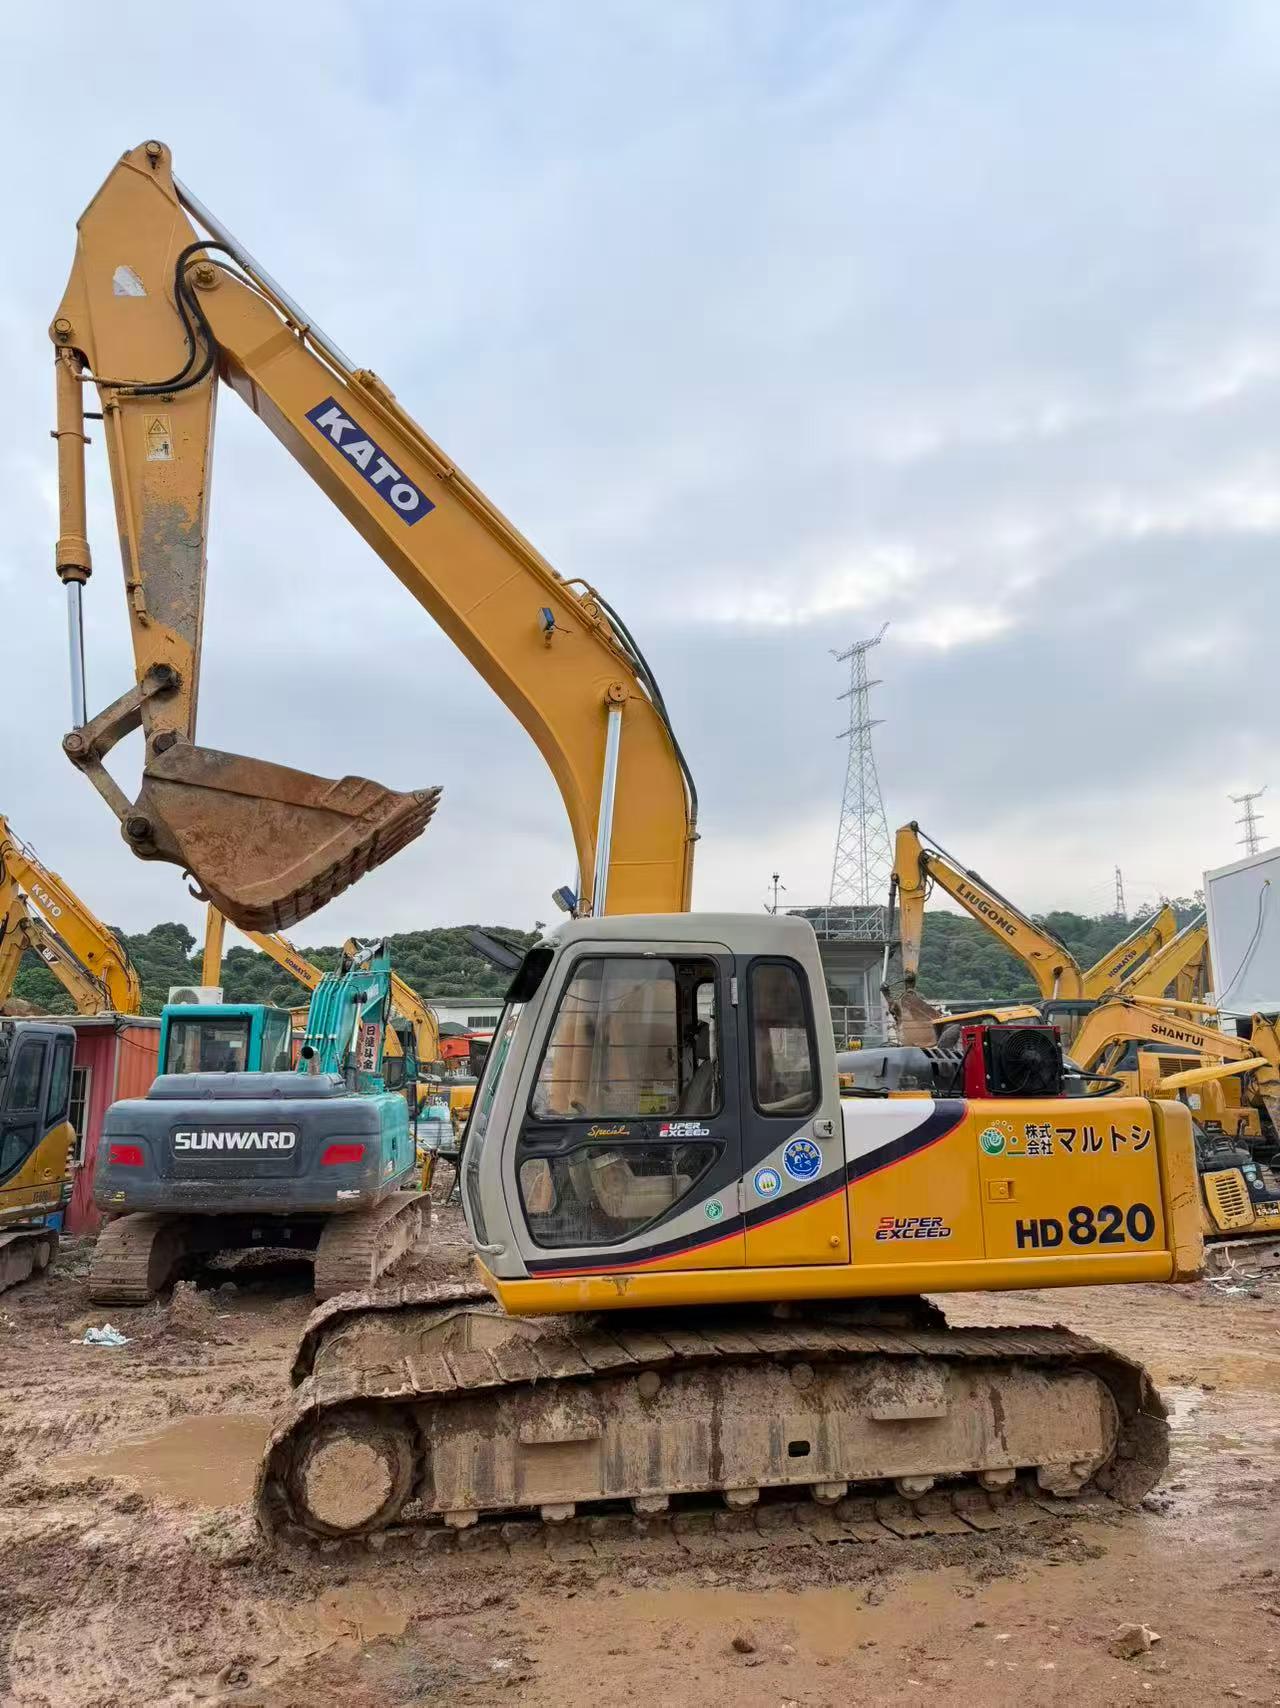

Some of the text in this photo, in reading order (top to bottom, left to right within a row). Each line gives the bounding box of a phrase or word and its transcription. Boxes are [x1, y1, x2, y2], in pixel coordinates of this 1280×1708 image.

[316, 406, 419, 511] KATO
[32, 883, 61, 917] KATO
[285, 957, 312, 980] KOMATSU
[1108, 949, 1137, 977] KOMATSU
[1151, 1023, 1204, 1047] SHANTUI
[175, 1131, 296, 1150] SUNWARD
[659, 1129, 710, 1138] EXCEED
[1025, 1124, 1052, 1140] 株式
[1056, 1125, 1151, 1152] マルトシ
[1027, 1140, 1053, 1155] 会社
[875, 1227, 952, 1240] EXCEED
[879, 1217, 943, 1229] SUPER
